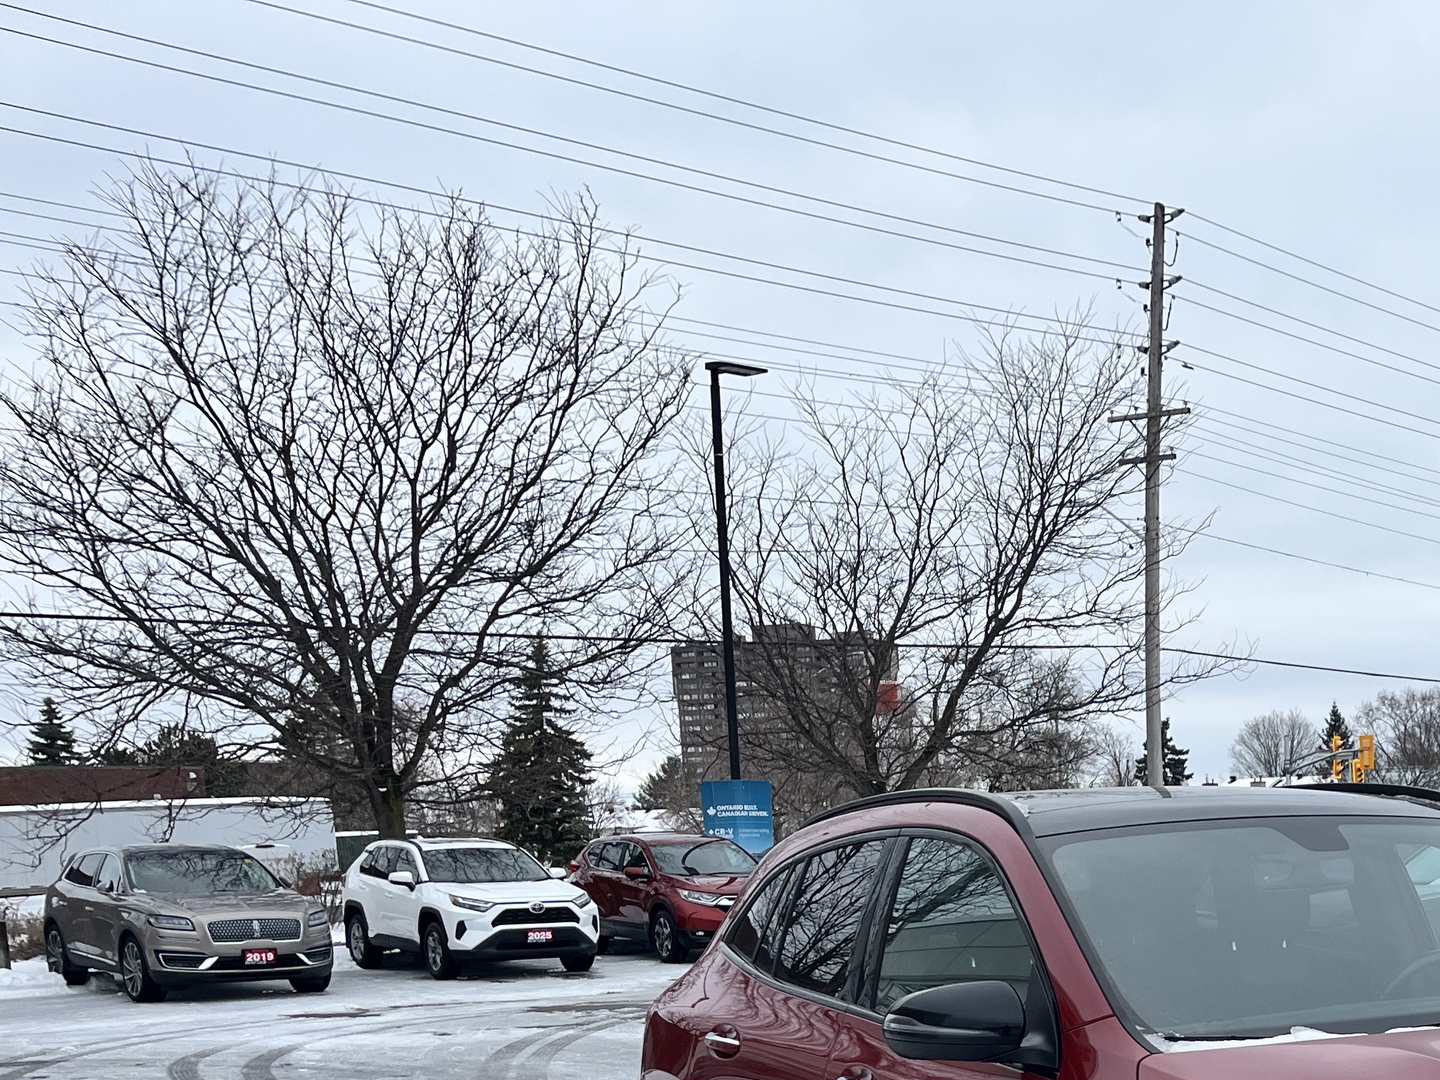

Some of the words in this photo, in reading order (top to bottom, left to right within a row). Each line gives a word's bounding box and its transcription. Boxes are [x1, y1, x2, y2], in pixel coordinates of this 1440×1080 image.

[716, 804, 744, 812] ONTARIO
[714, 827, 734, 836] CR-V
[527, 931, 553, 940] 2025
[246, 951, 274, 962] 2019
